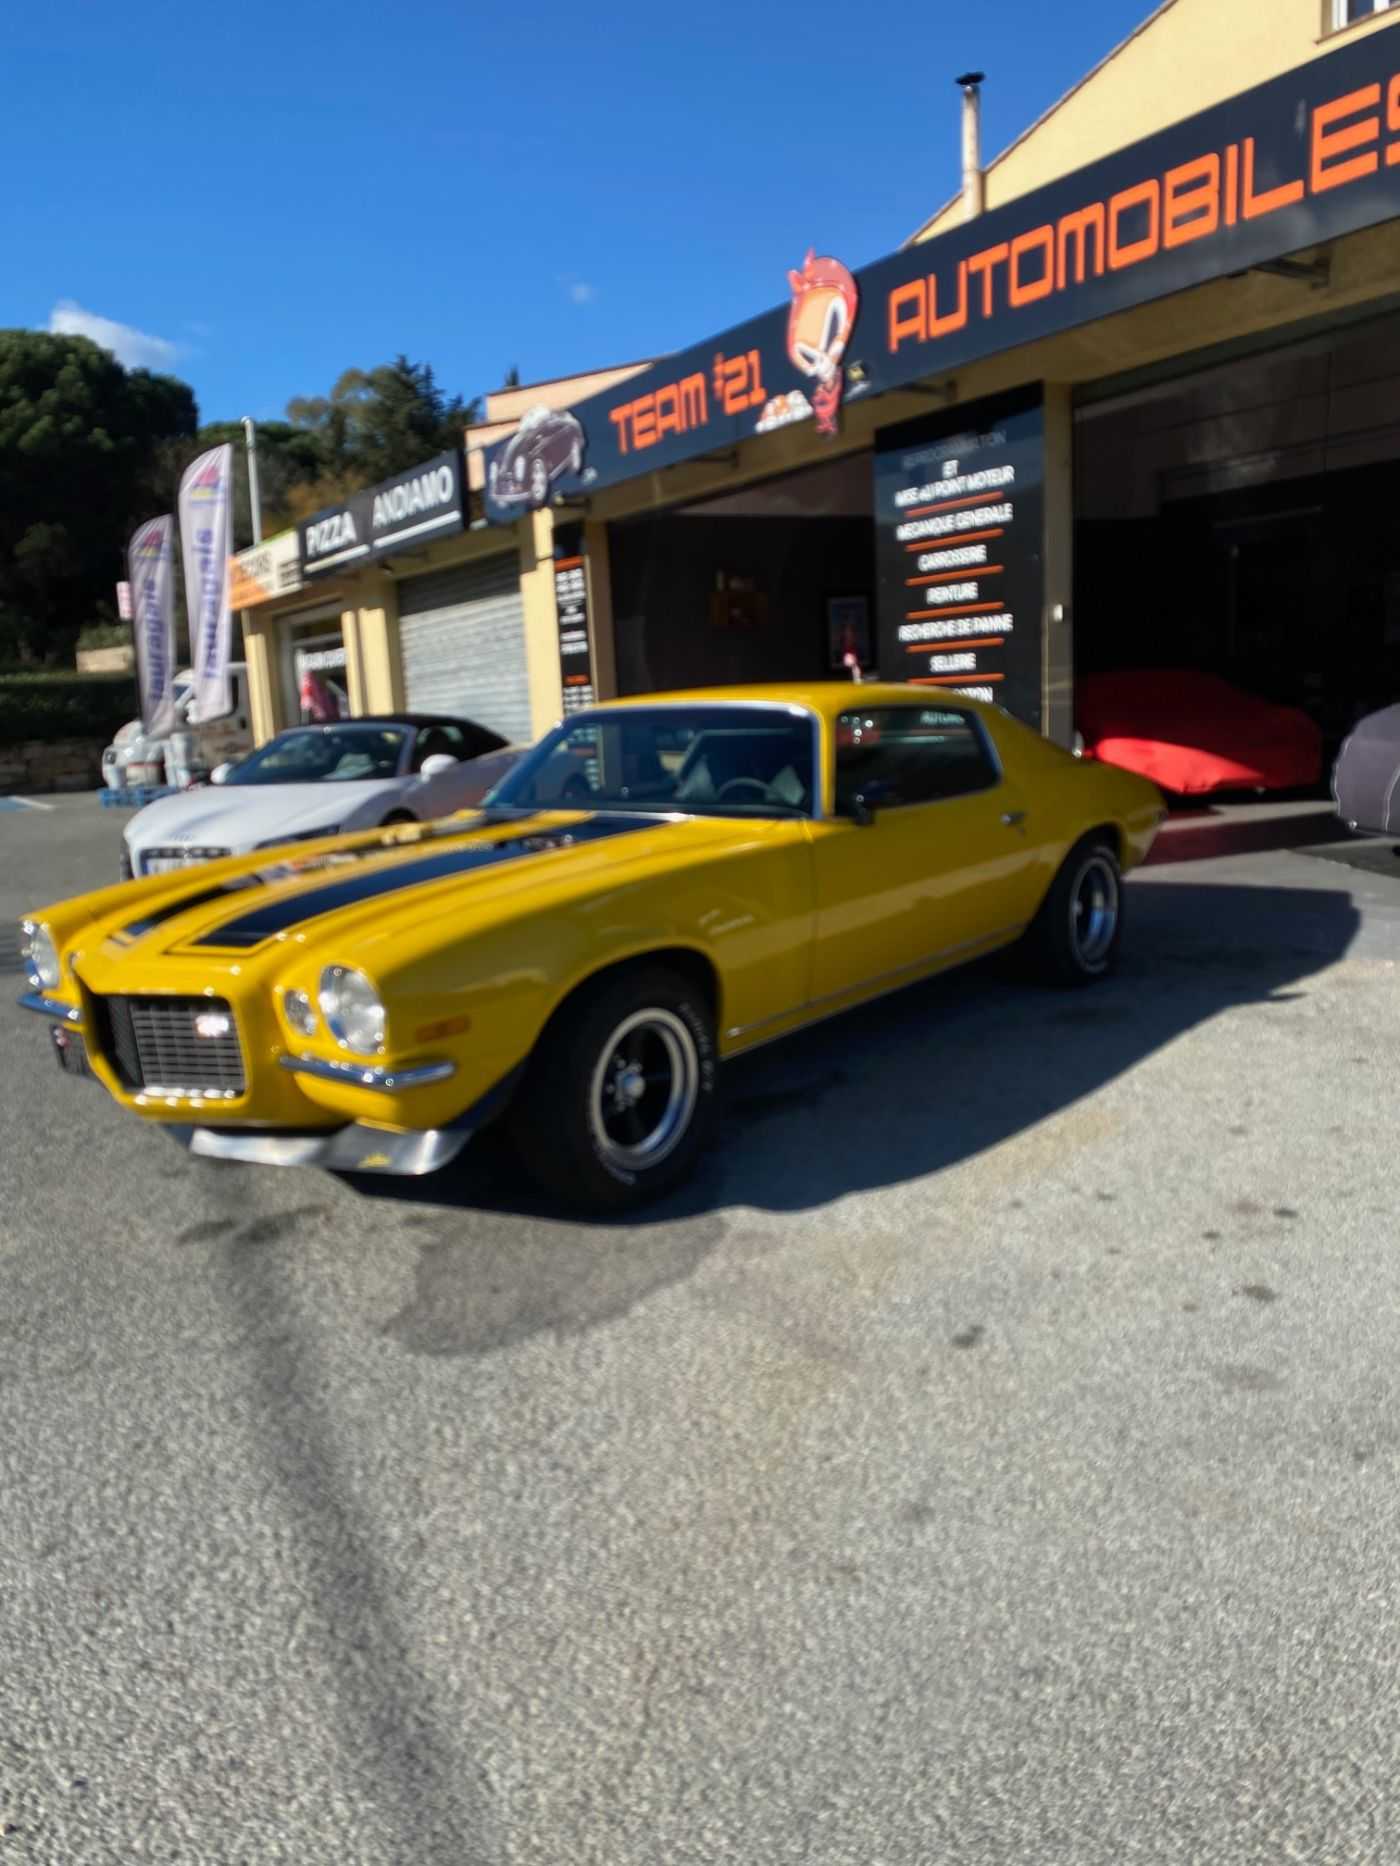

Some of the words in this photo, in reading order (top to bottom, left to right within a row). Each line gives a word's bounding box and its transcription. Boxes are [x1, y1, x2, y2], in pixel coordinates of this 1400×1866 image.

[609, 372, 709, 455] TEAM
[888, 73, 1400, 352] AUTOMOBILE
[304, 511, 358, 556] PIZZA
[372, 465, 455, 529] ANDIAMO
